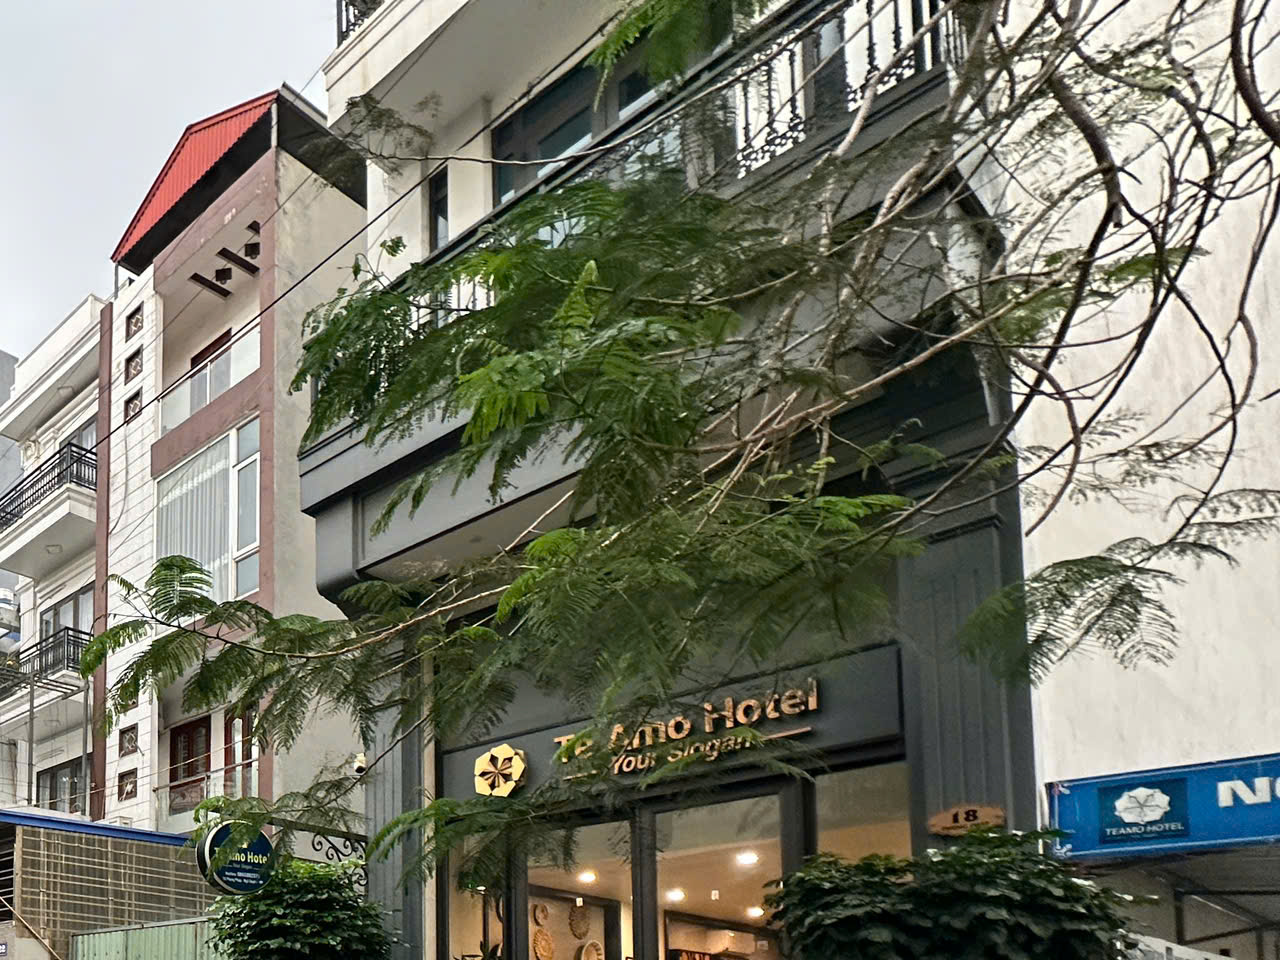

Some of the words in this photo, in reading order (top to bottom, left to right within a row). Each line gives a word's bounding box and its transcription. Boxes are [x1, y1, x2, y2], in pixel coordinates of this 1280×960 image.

[607, 714, 693, 752] Amo
[702, 676, 819, 734] Hotel
[1216, 775, 1280, 809] N
[951, 809, 978, 824] 18
[1105, 825, 1144, 836] TEAMO
[1145, 822, 1185, 833] HOTEL
